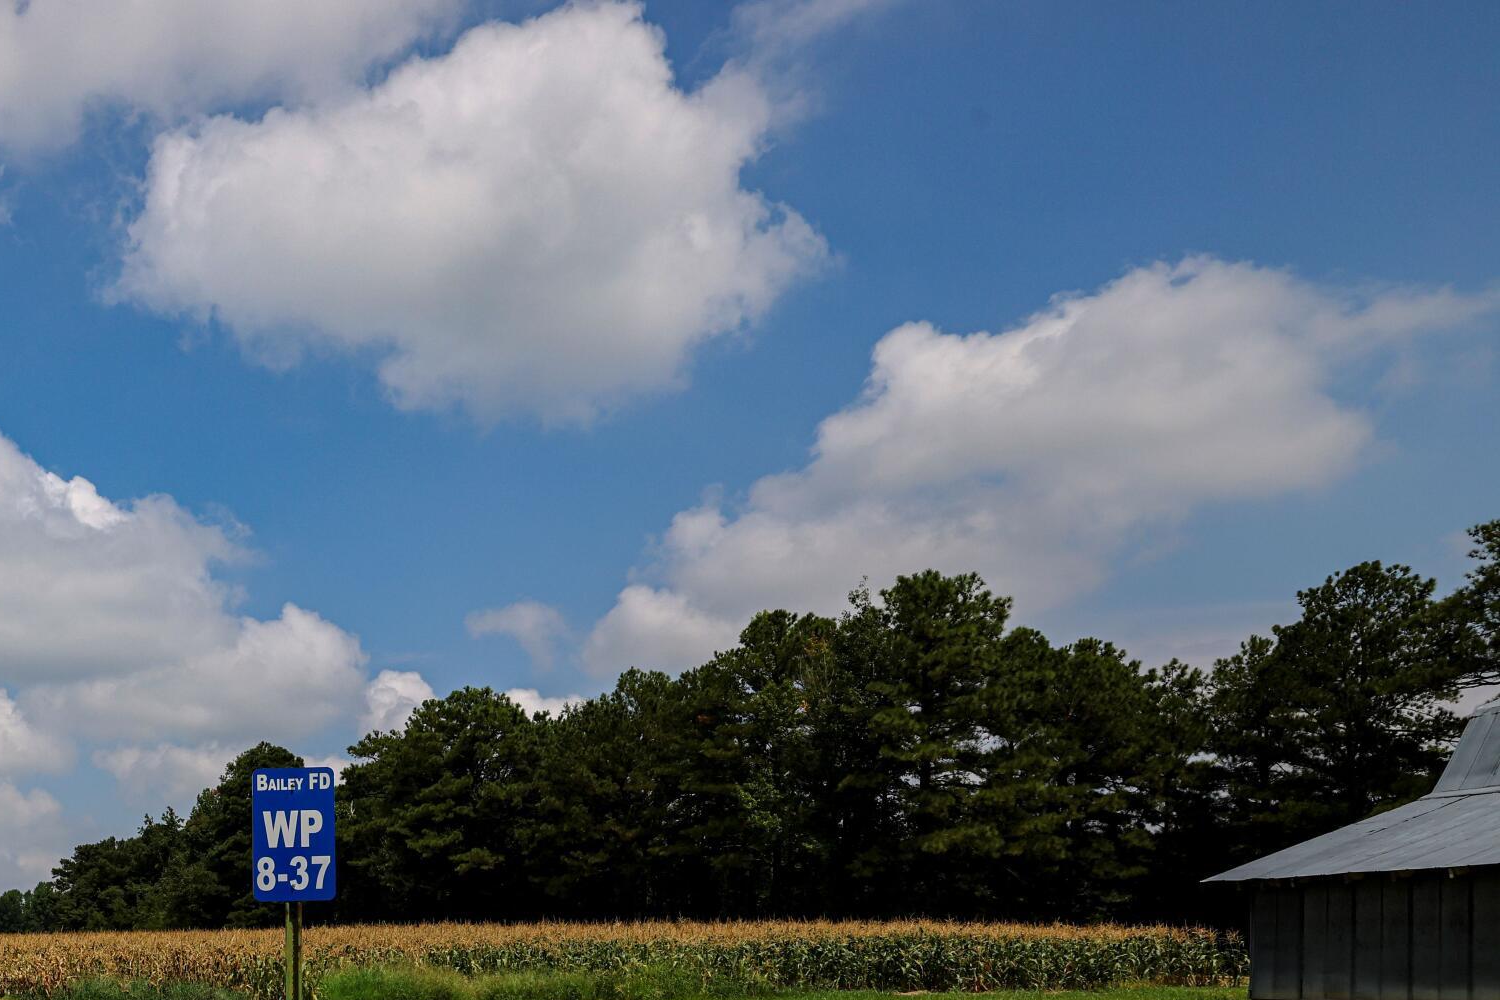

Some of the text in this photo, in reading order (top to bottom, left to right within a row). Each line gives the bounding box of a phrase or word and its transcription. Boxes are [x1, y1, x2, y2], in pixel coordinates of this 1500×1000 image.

[256, 773, 331, 791] BAILEY FD
[262, 809, 324, 849] WP
[256, 855, 331, 892] 8-37
